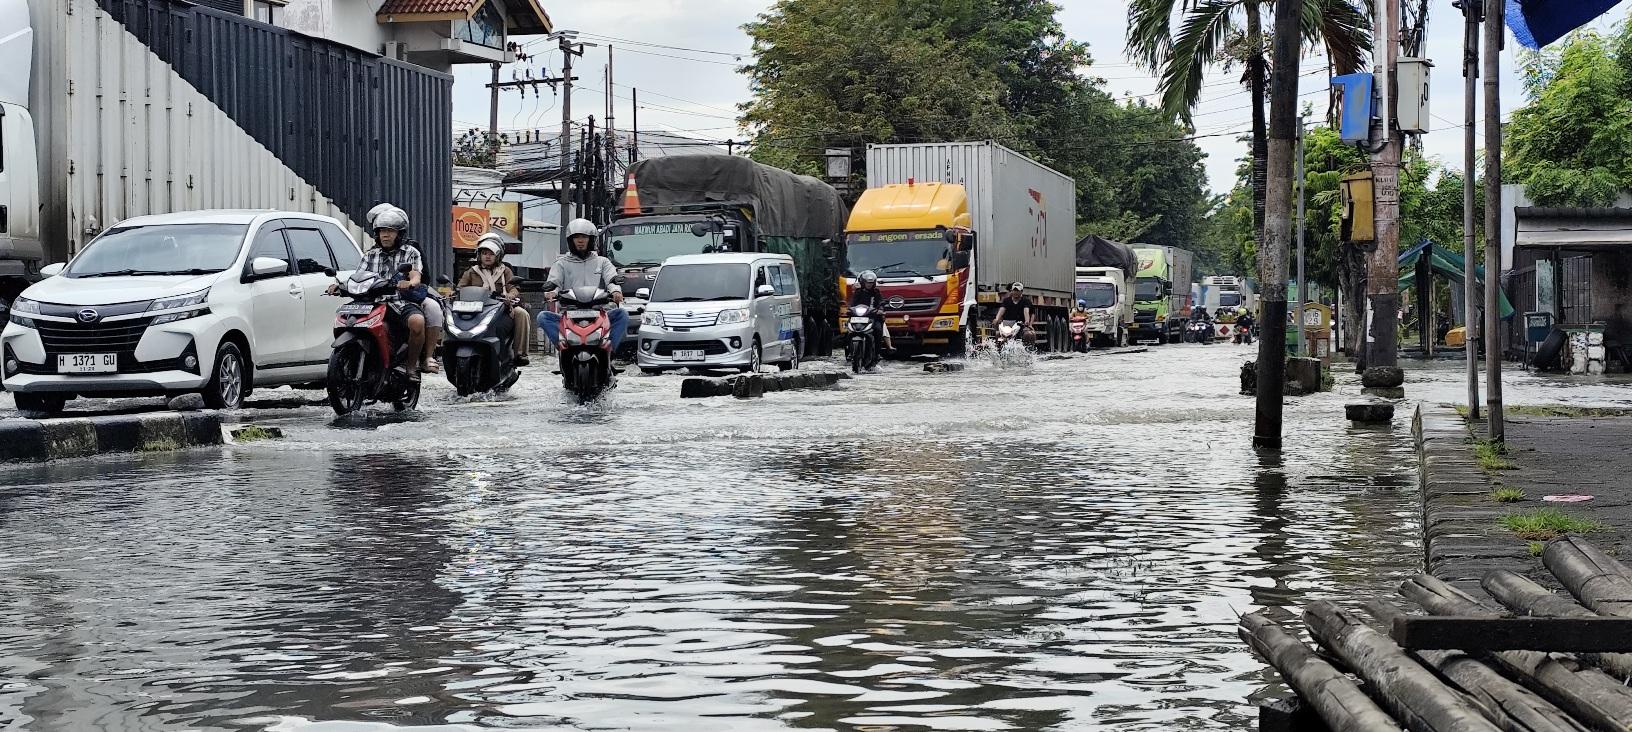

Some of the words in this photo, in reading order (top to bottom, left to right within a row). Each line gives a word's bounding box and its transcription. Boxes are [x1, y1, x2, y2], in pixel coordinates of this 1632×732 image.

[59, 355, 65, 366] H
[72, 355, 95, 366] 1371
[103, 354, 115, 366] GU
